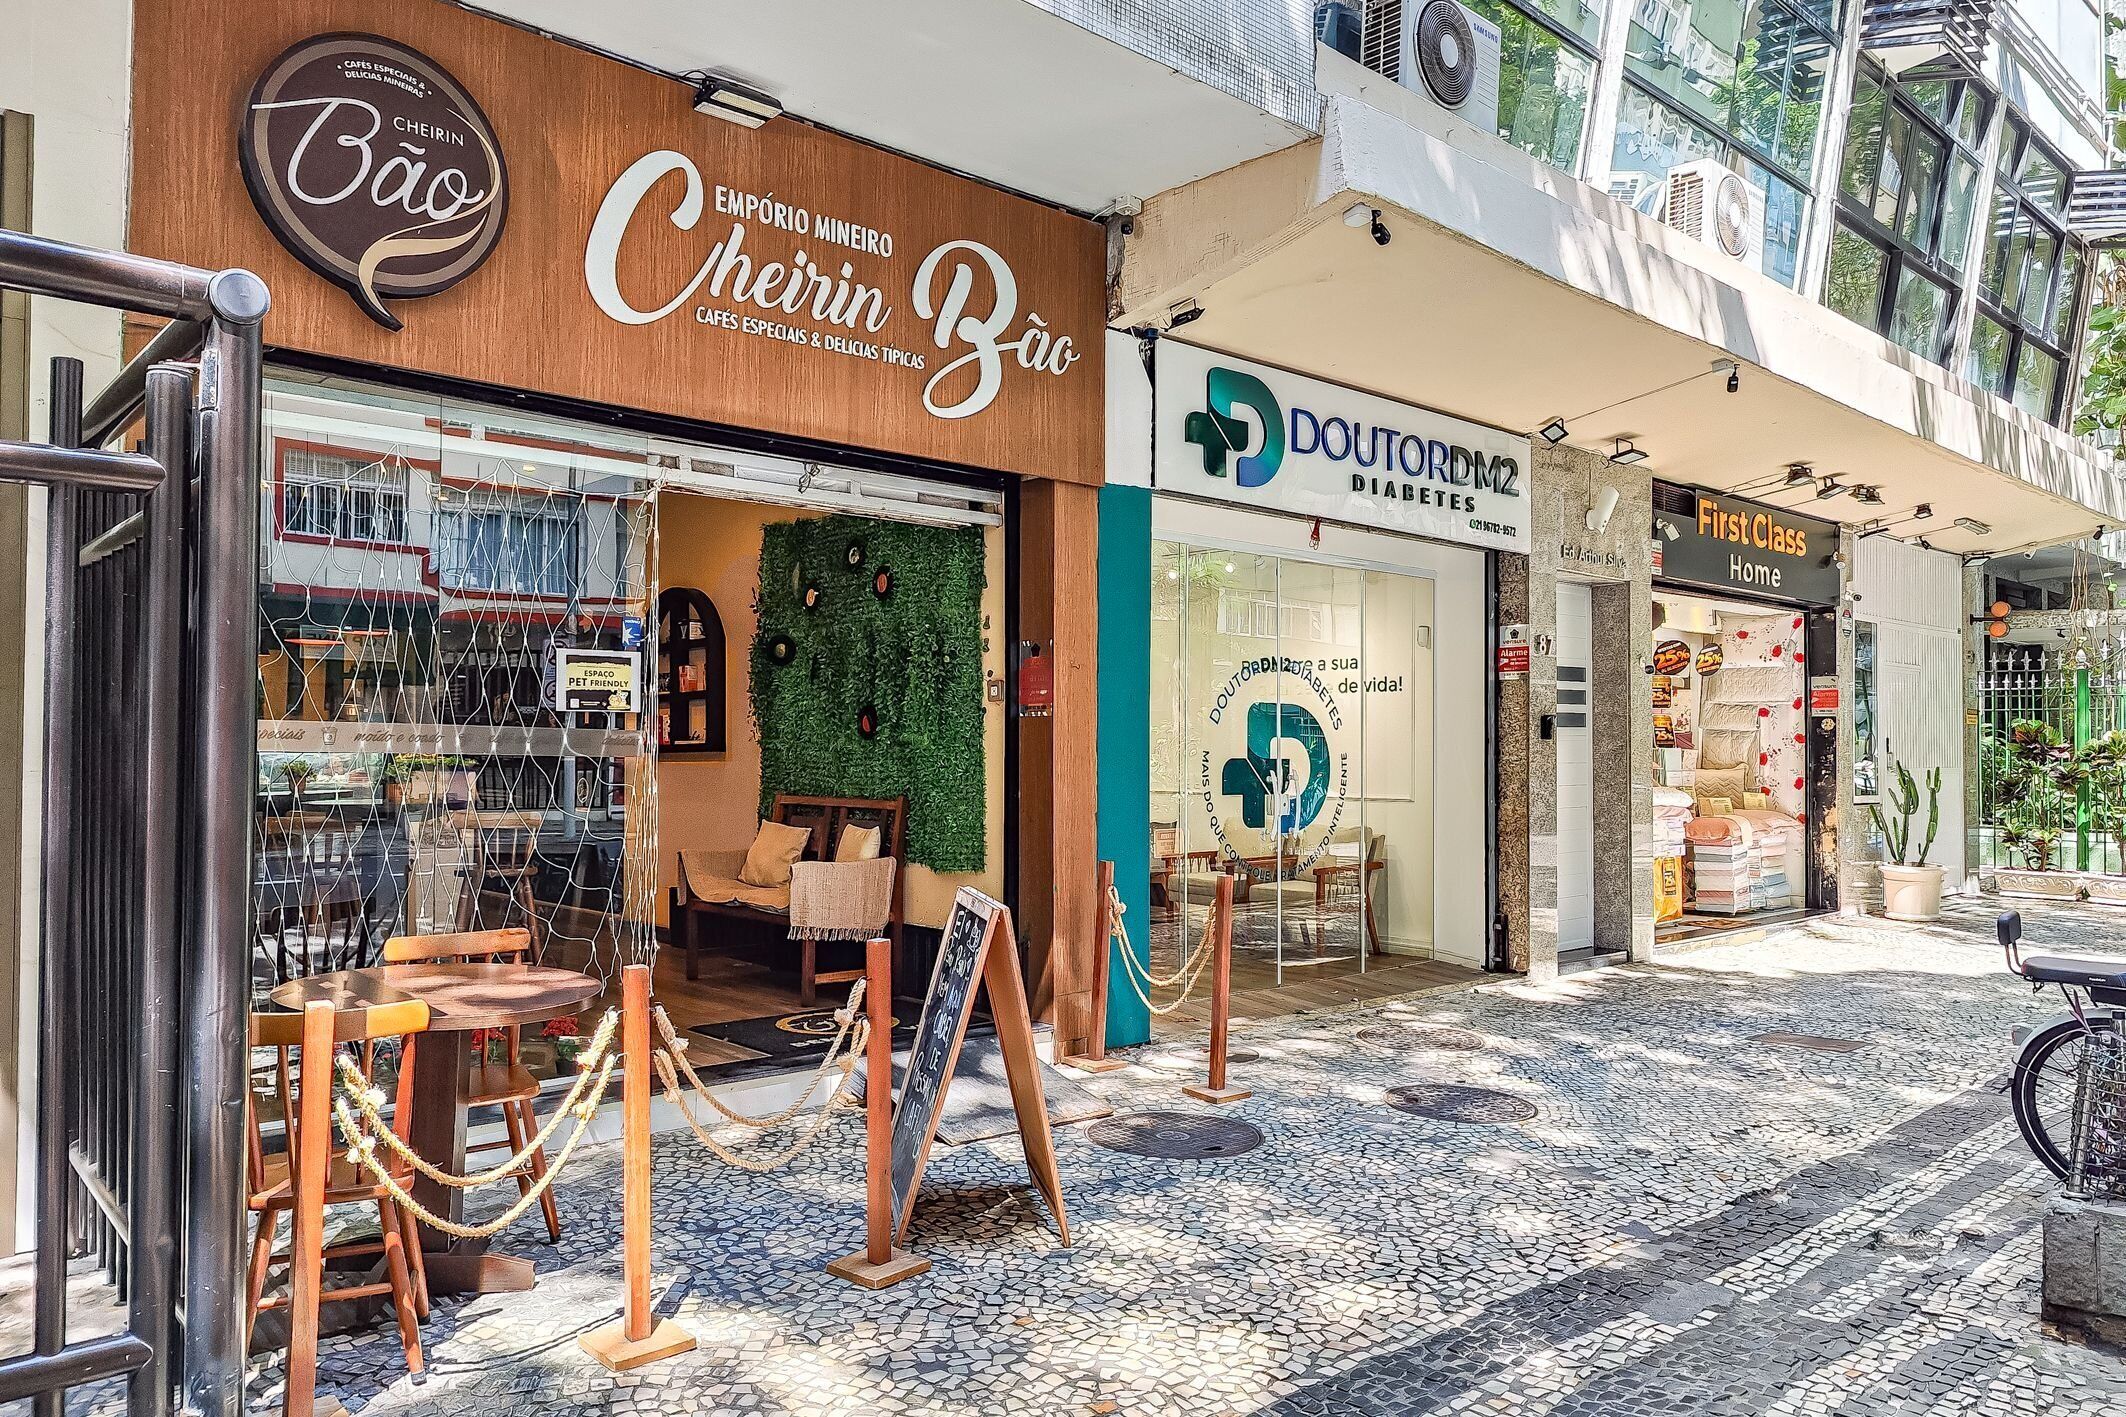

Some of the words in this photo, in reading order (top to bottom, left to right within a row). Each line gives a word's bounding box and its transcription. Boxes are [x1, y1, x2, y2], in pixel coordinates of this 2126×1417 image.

[1473, 22, 1499, 43] SAMSUNG
[344, 60, 373, 70] CAFÉS
[374, 63, 417, 85] ESPECIAIS
[419, 82, 426, 90] &
[384, 76, 424, 99] MINEIRAS
[393, 116, 465, 147] CHEIRIN
[251, 97, 485, 221] Bão
[715, 185, 810, 235] EMPÓRIO
[814, 213, 893, 258] MINEIRO
[585, 150, 893, 333] Cheirin
[912, 239, 1081, 420] Bão
[695, 305, 739, 330] CAFÉS
[741, 316, 808, 345] ESPECIAIS
[810, 331, 822, 349] &
[824, 334, 879, 361] DELÍCIAS
[881, 342, 926, 370] TÍPICAS
[1291, 407, 1520, 498] DOUTORDM2
[1352, 473, 1476, 513] DIABETES
[1697, 498, 1750, 546] First
[1751, 513, 1808, 557] Class
[1728, 553, 1781, 588] Home
[1331, 657, 1359, 671] sua
[1500, 649, 1529, 657] Alarme
[1654, 649, 1690, 670] 25%
[1696, 651, 1723, 670] 25%
[569, 677, 588, 687] PET
[590, 679, 629, 688] FRIENDLY
[584, 670, 615, 679] ESPAÇO
[1338, 677, 1359, 694] de
[1363, 676, 1403, 693] vida!
[258, 728, 306, 741] peciais
[1201, 750, 1210, 788] MAIS
[1203, 791, 1214, 813] DO
[1330, 752, 1348, 836] INTELIGENTE
[1210, 815, 1227, 845] QUE
